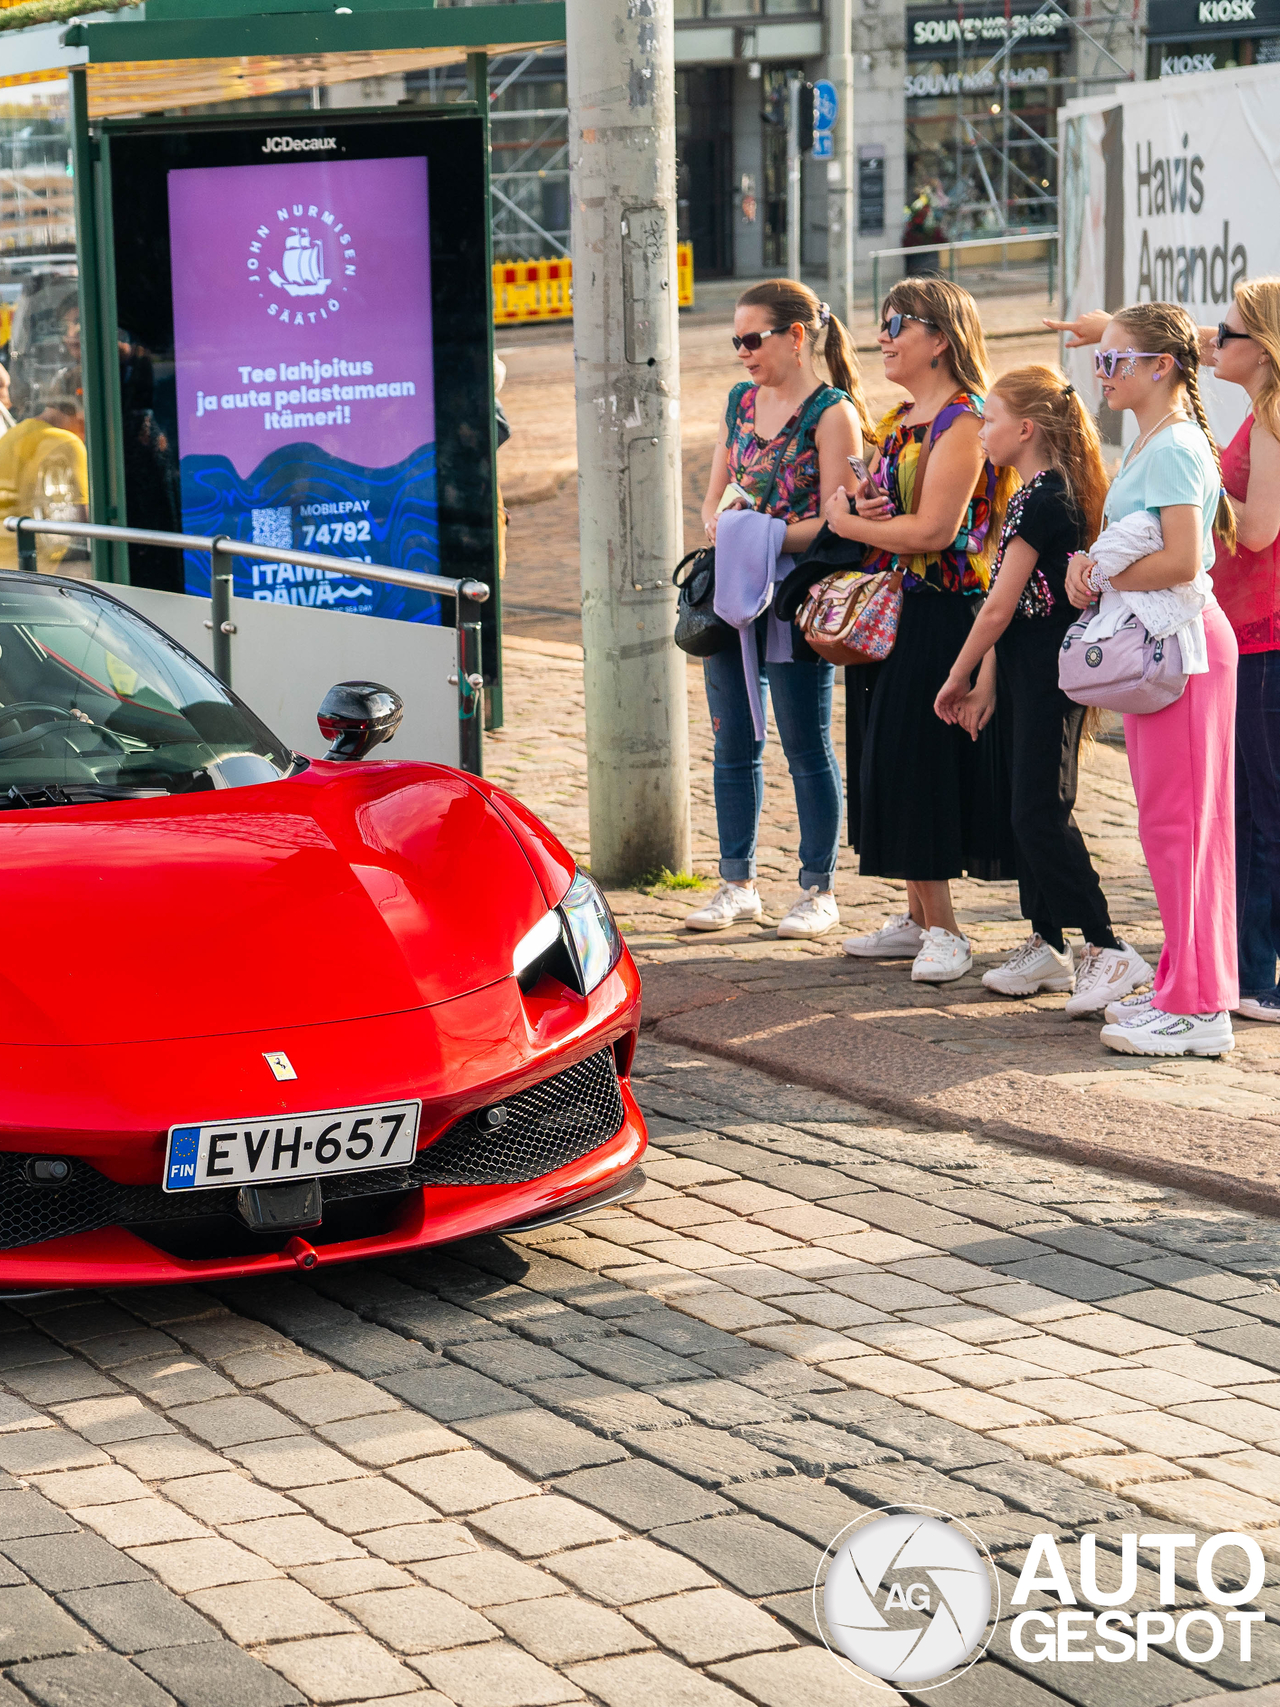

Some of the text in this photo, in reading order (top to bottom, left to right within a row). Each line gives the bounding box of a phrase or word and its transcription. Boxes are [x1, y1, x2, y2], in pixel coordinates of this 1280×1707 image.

[1199, 0, 1257, 23] KIOSK
[1161, 53, 1216, 75] KIOSK
[261, 136, 337, 153] JCDecaux
[1136, 131, 1205, 215] Havis
[247, 204, 356, 281] JOHN NURMISEN
[1137, 218, 1248, 304] Amanda
[267, 298, 340, 325] SÄÄTIÖ
[238, 357, 374, 385] Tee lahjoitus
[196, 381, 416, 417] ja auta pelastamaan
[264, 405, 351, 430] Itämeri!
[300, 500, 371, 517] MOBILEPAY
[302, 520, 372, 546] 74792
[171, 1113, 407, 1178] FIN EVH-657
